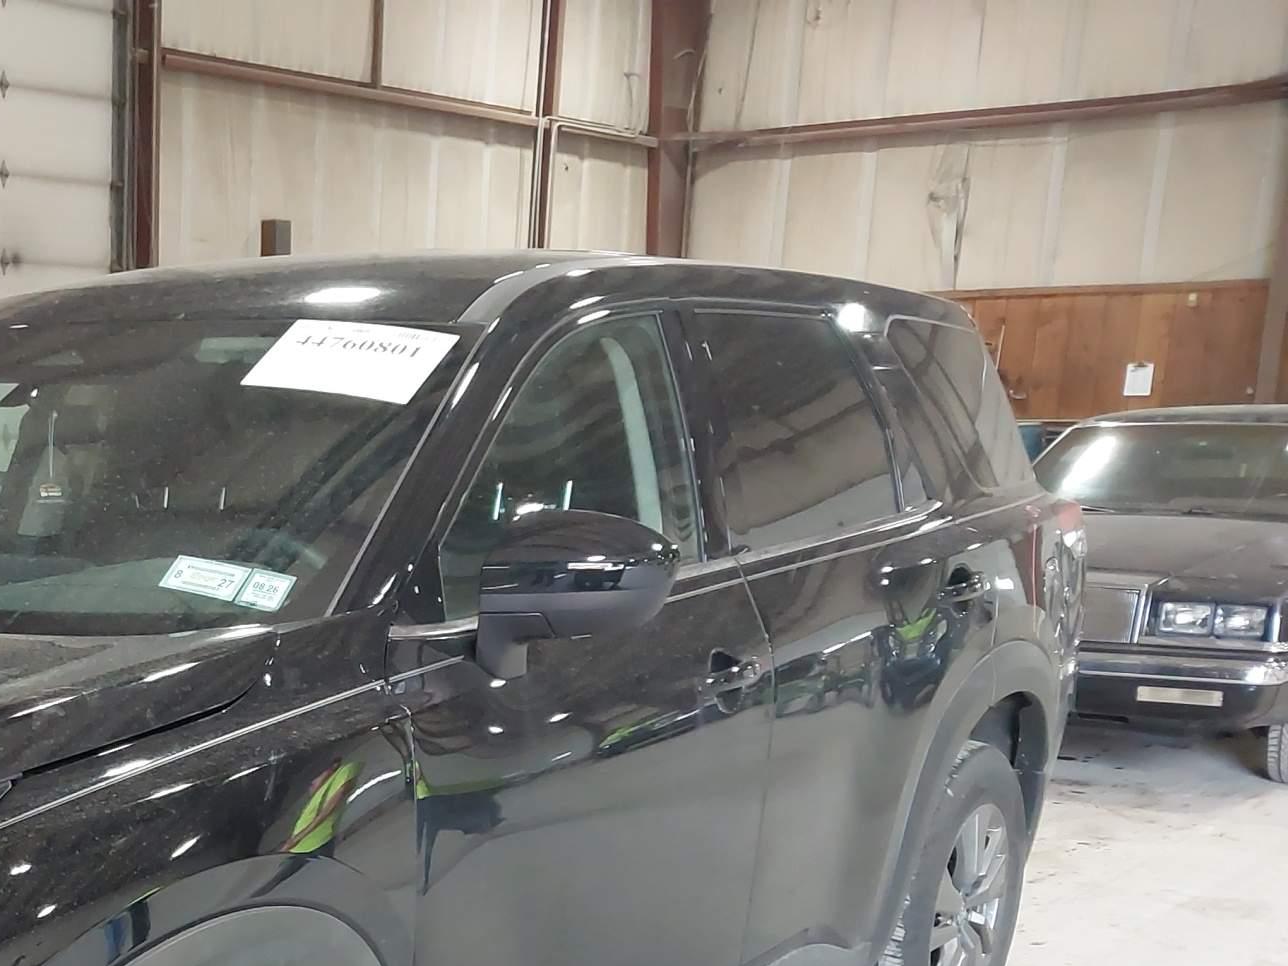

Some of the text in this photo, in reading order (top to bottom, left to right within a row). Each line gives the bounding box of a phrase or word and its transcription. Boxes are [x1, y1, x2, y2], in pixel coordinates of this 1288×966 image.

[296, 335, 421, 358] 44760801
[174, 569, 184, 579] 8
[216, 578, 235, 589] 27
